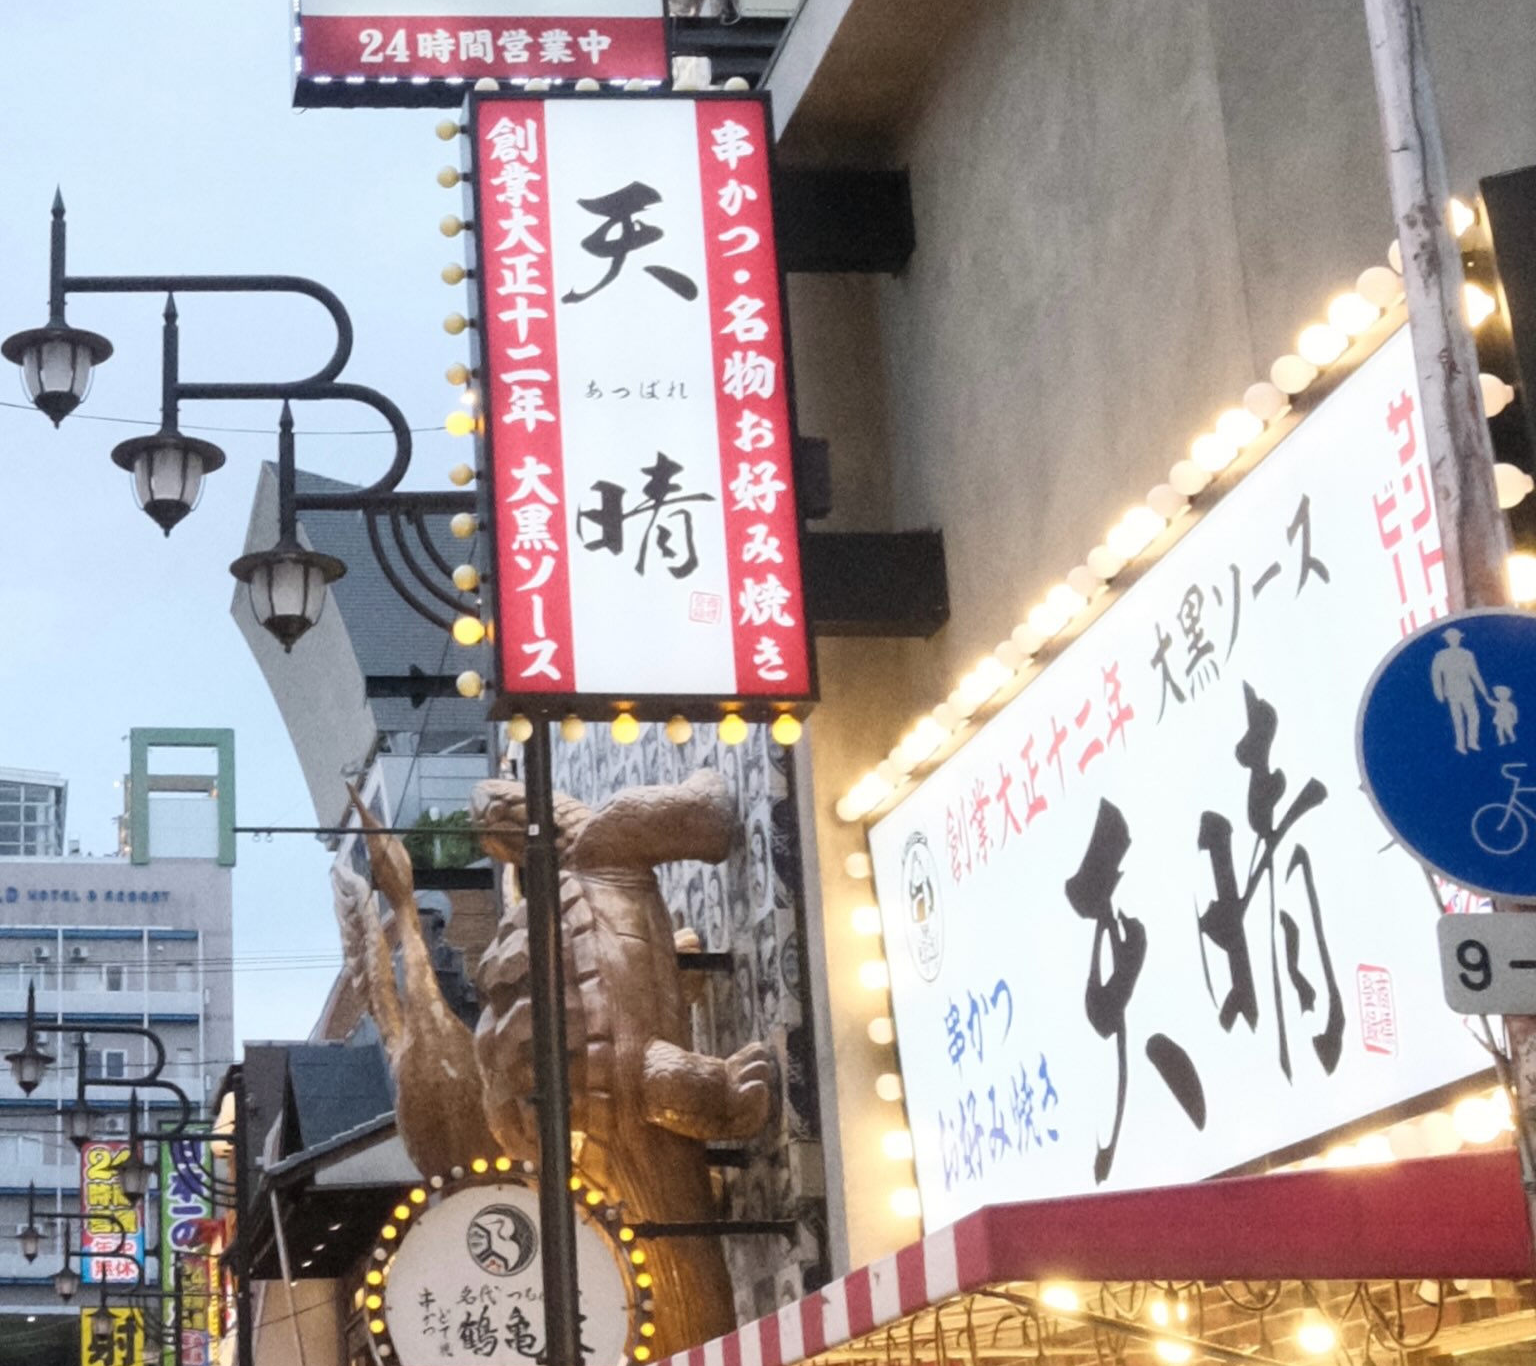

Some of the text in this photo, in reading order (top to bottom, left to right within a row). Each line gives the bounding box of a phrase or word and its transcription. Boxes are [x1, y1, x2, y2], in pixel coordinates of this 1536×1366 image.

[359, 28, 611, 64] 24時間営業中
[485, 116, 561, 680] 創業大正十二年 大黒ソース
[1386, 390, 1449, 619] サント
[1149, 492, 1330, 725] 大黒ソース
[944, 661, 1134, 889] 創業大正十二年
[944, 979, 1013, 1078] 串かつ
[458, 1305, 595, 1357] 鶴亀
